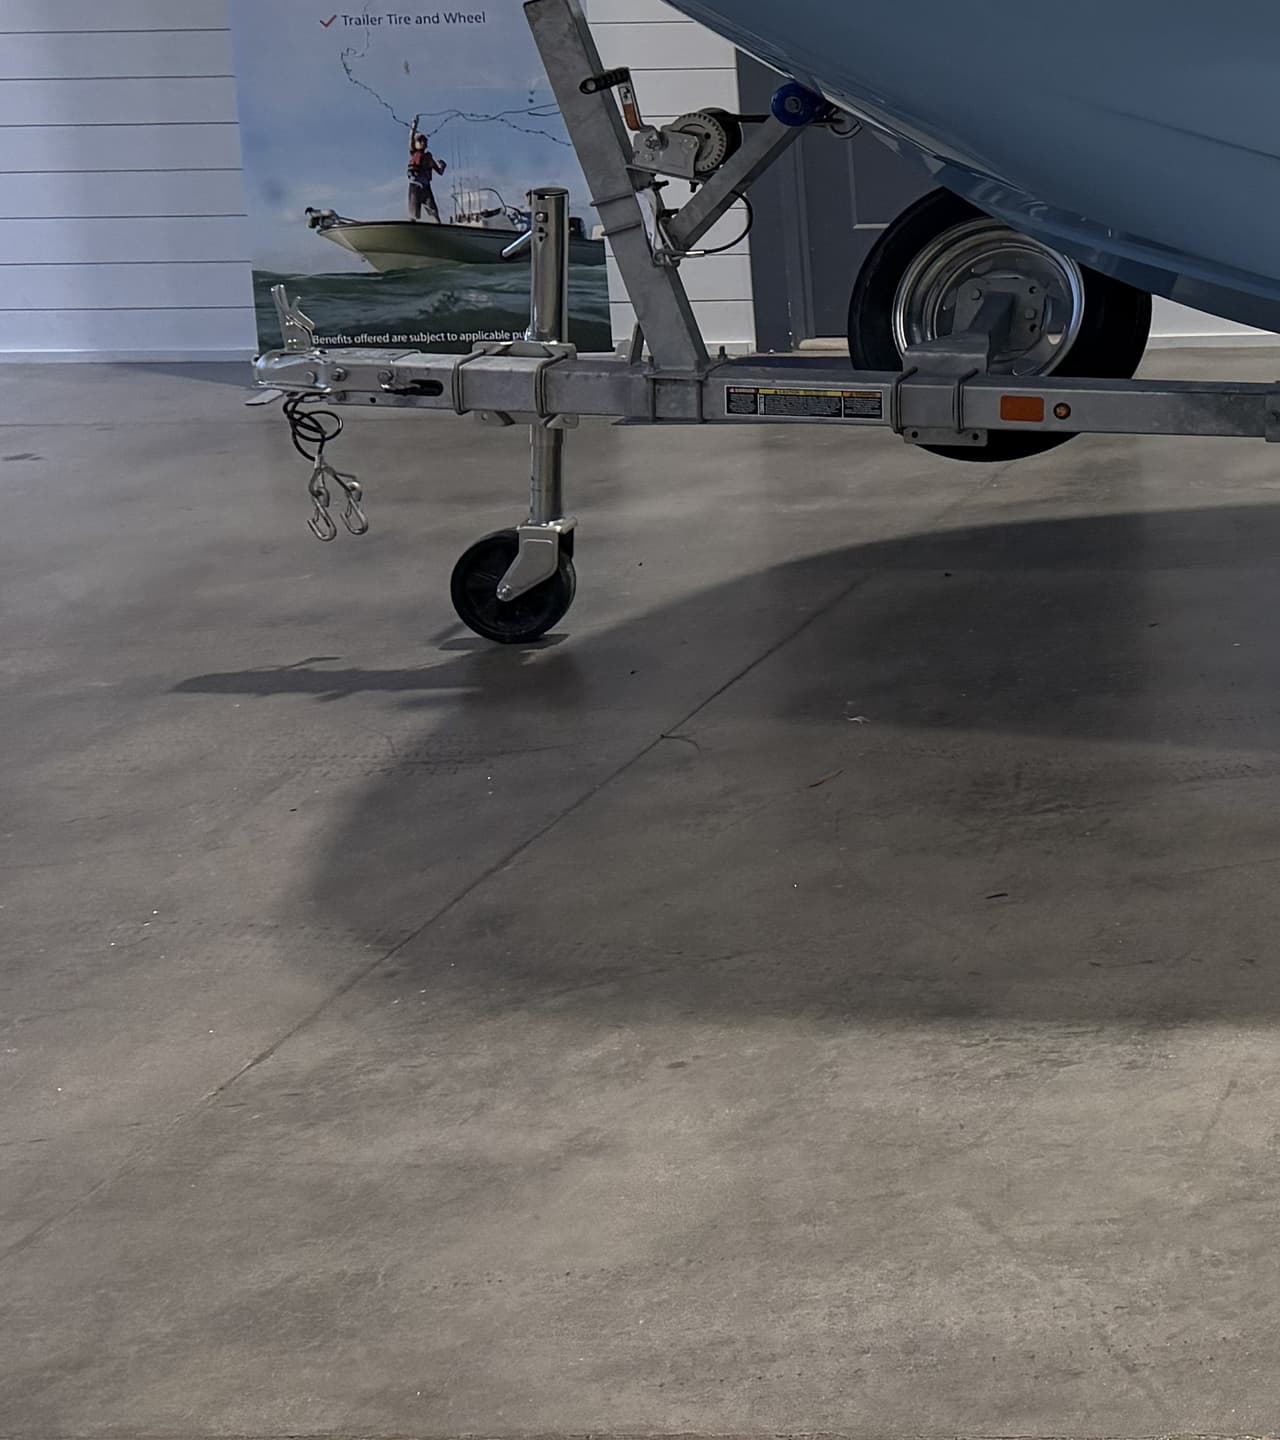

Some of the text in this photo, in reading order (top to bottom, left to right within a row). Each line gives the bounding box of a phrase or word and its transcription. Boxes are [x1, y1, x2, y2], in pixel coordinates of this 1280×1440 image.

[342, 11, 487, 27] Trailer Tire and Wheel
[354, 332, 390, 344] offered
[392, 334, 408, 343] are
[409, 332, 445, 345] subject
[447, 332, 458, 341] to
[459, 330, 511, 343] applicable
